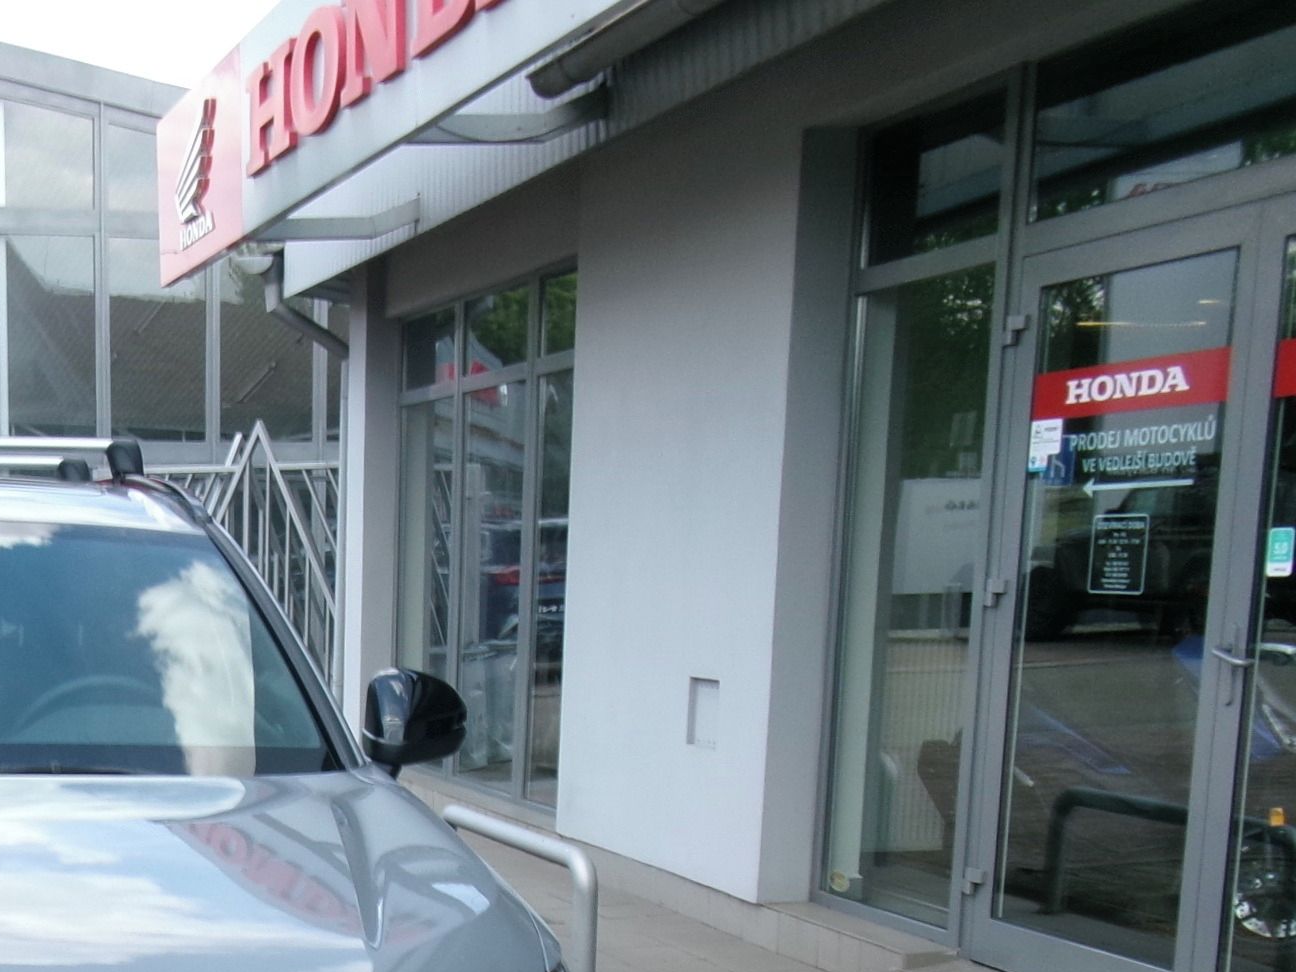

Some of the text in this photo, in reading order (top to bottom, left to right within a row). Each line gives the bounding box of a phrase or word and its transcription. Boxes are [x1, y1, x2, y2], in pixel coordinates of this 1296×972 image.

[179, 210, 215, 251] HONDA
[1065, 365, 1189, 404] HONDA
[1069, 414, 1217, 453] PRODEJ MOTOCYKLŮ
[1082, 446, 1197, 473] VE VEDLEJŠÍ BUDOVĚ
